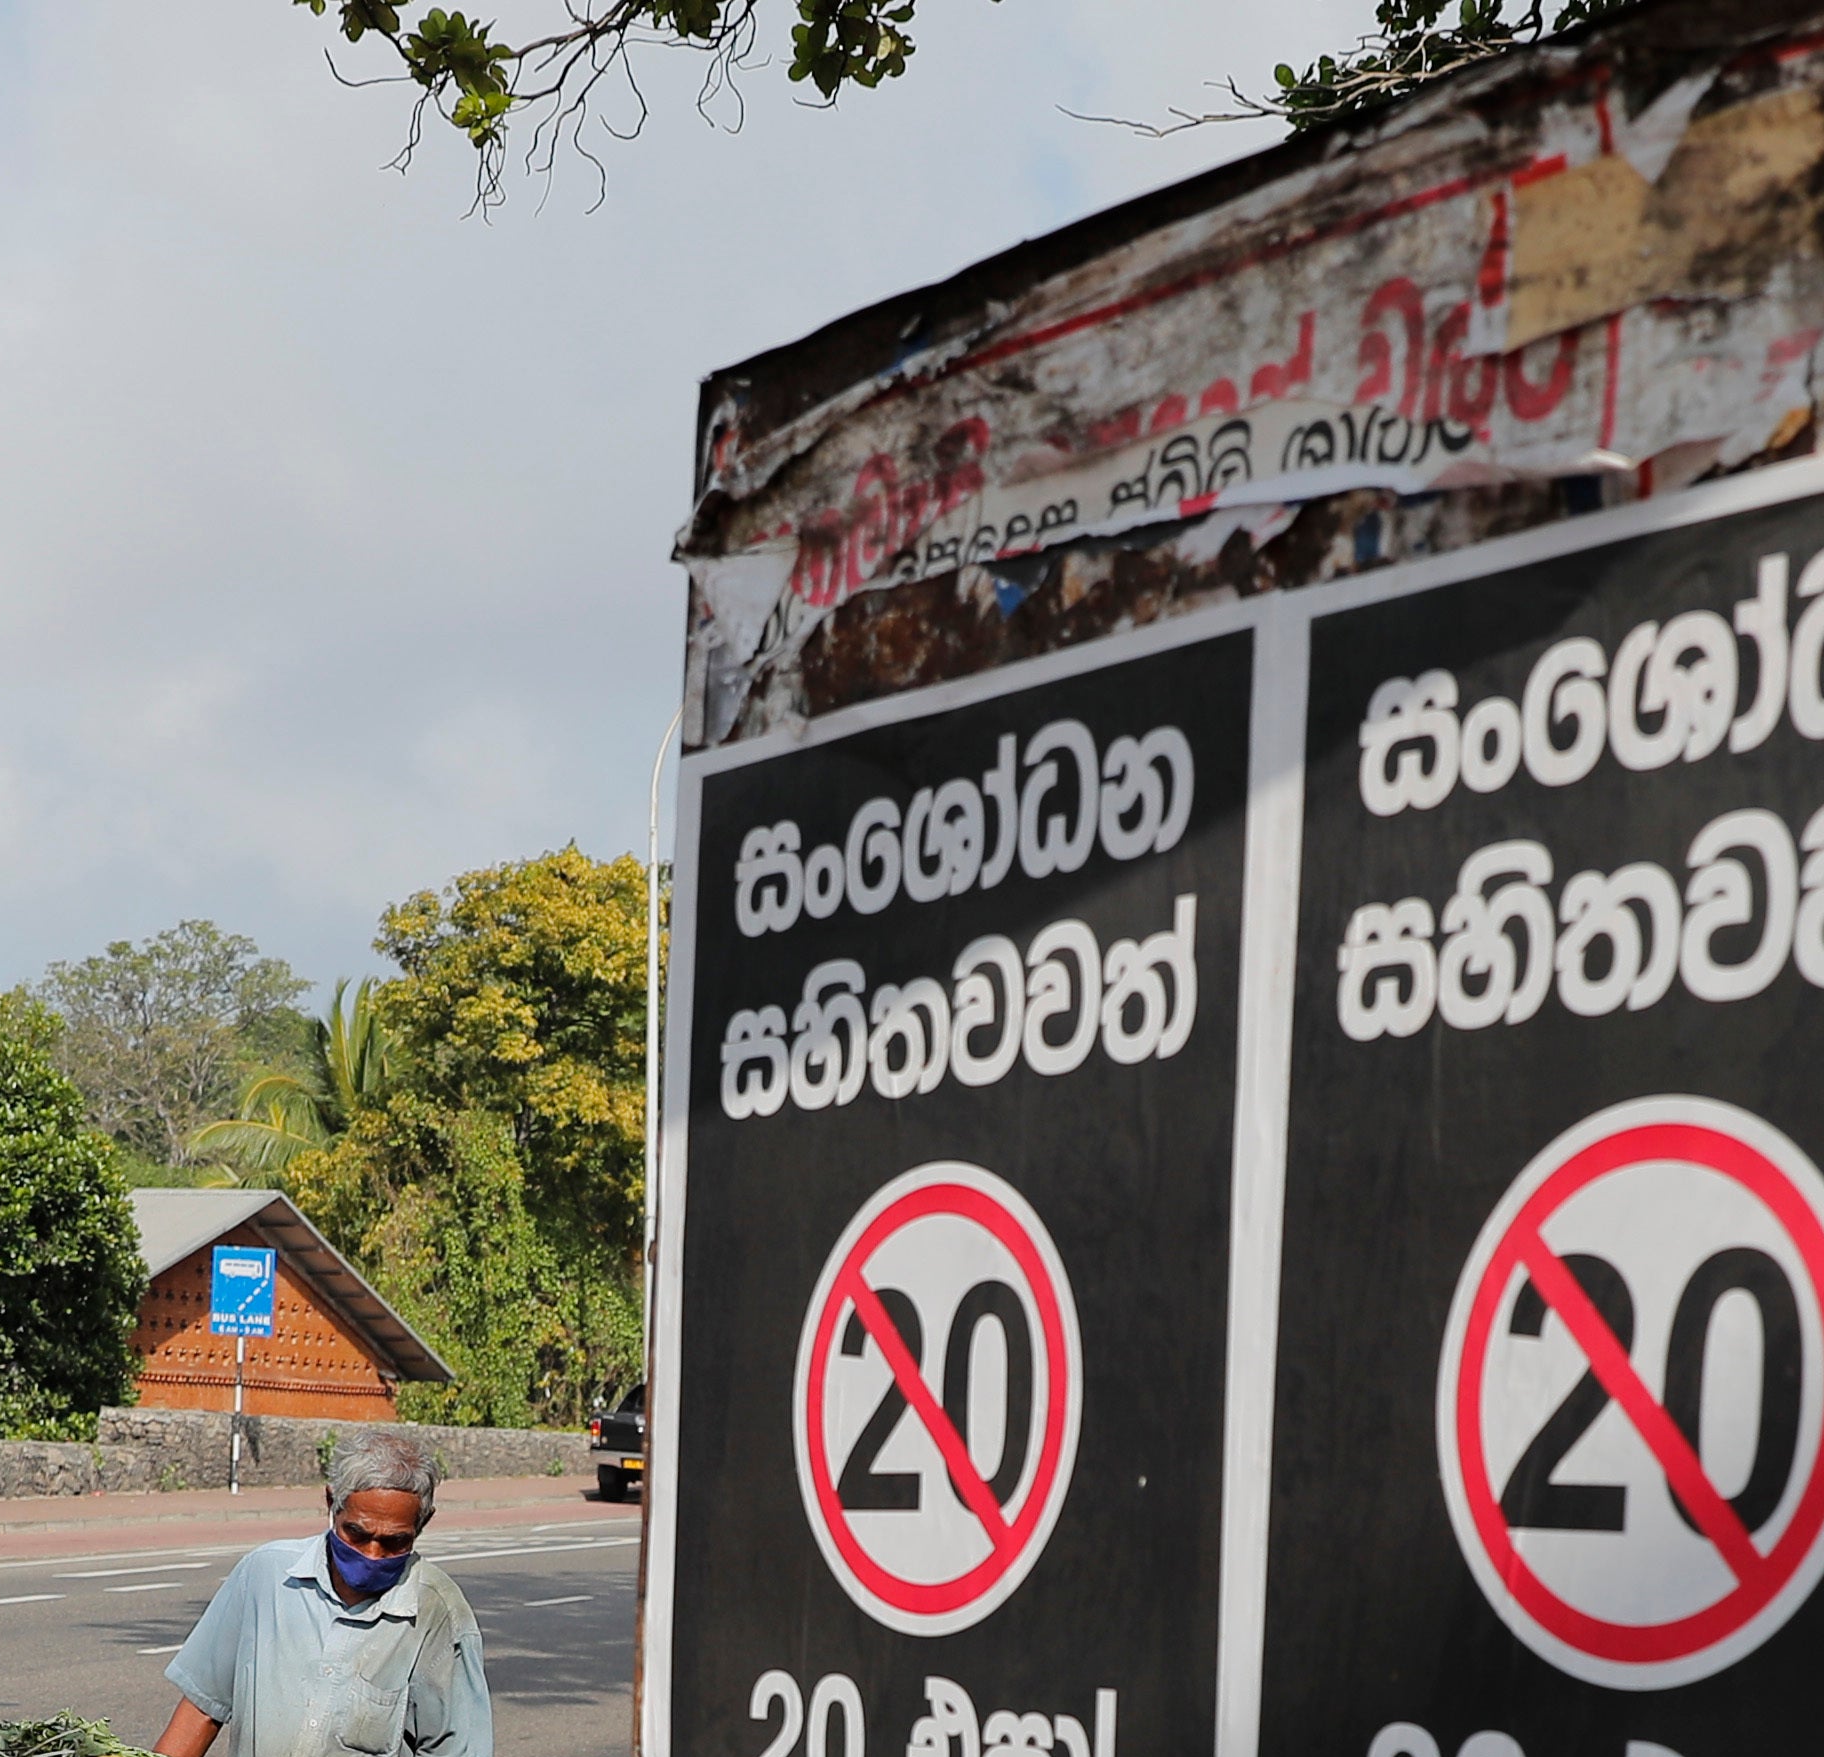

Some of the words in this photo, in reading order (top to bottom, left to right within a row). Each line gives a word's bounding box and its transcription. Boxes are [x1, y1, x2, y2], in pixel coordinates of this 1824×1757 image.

[734, 717, 1195, 938] සංශෝධන
[720, 892, 1198, 1121] සහිතවවත්
[212, 1312, 237, 1323] BUS
[239, 1314, 271, 1326] LANE
[834, 1279, 1034, 1516] 20
[1498, 1245, 1805, 1540] 20
